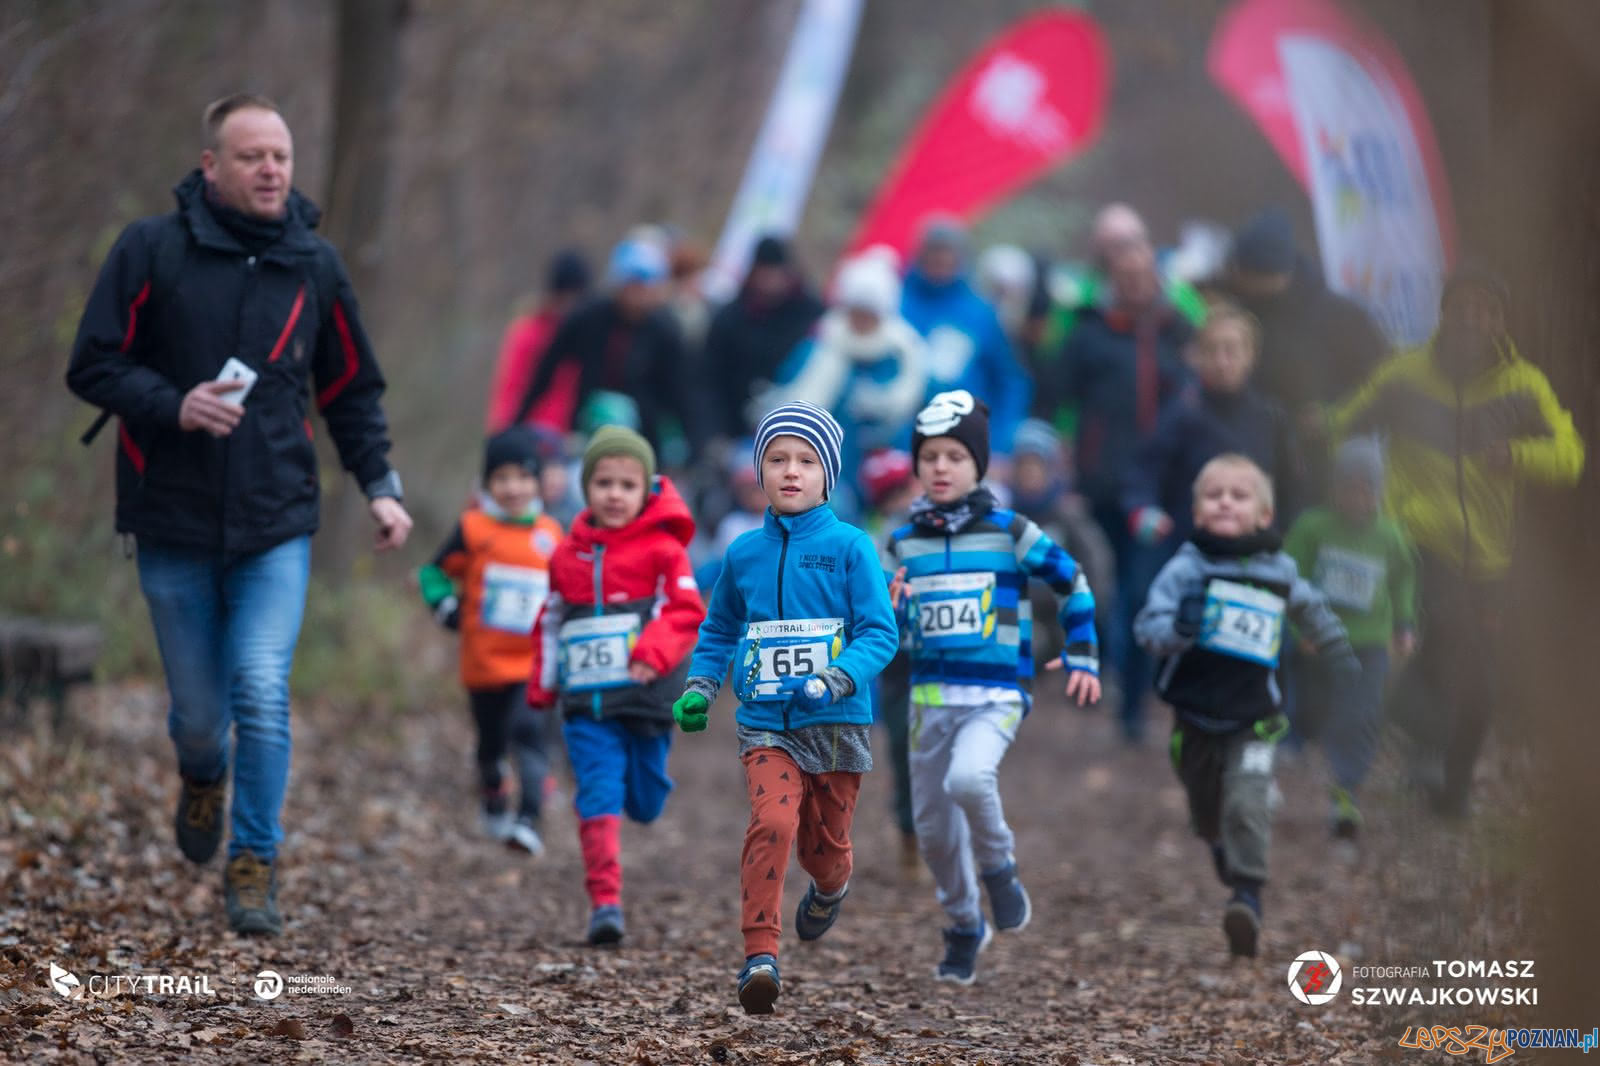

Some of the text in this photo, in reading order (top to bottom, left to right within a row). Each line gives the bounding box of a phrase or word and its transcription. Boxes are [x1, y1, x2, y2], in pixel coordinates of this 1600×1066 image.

[922, 604, 977, 631] 204
[1233, 611, 1266, 642] 42
[578, 642, 614, 669] 26
[773, 648, 814, 677] 65
